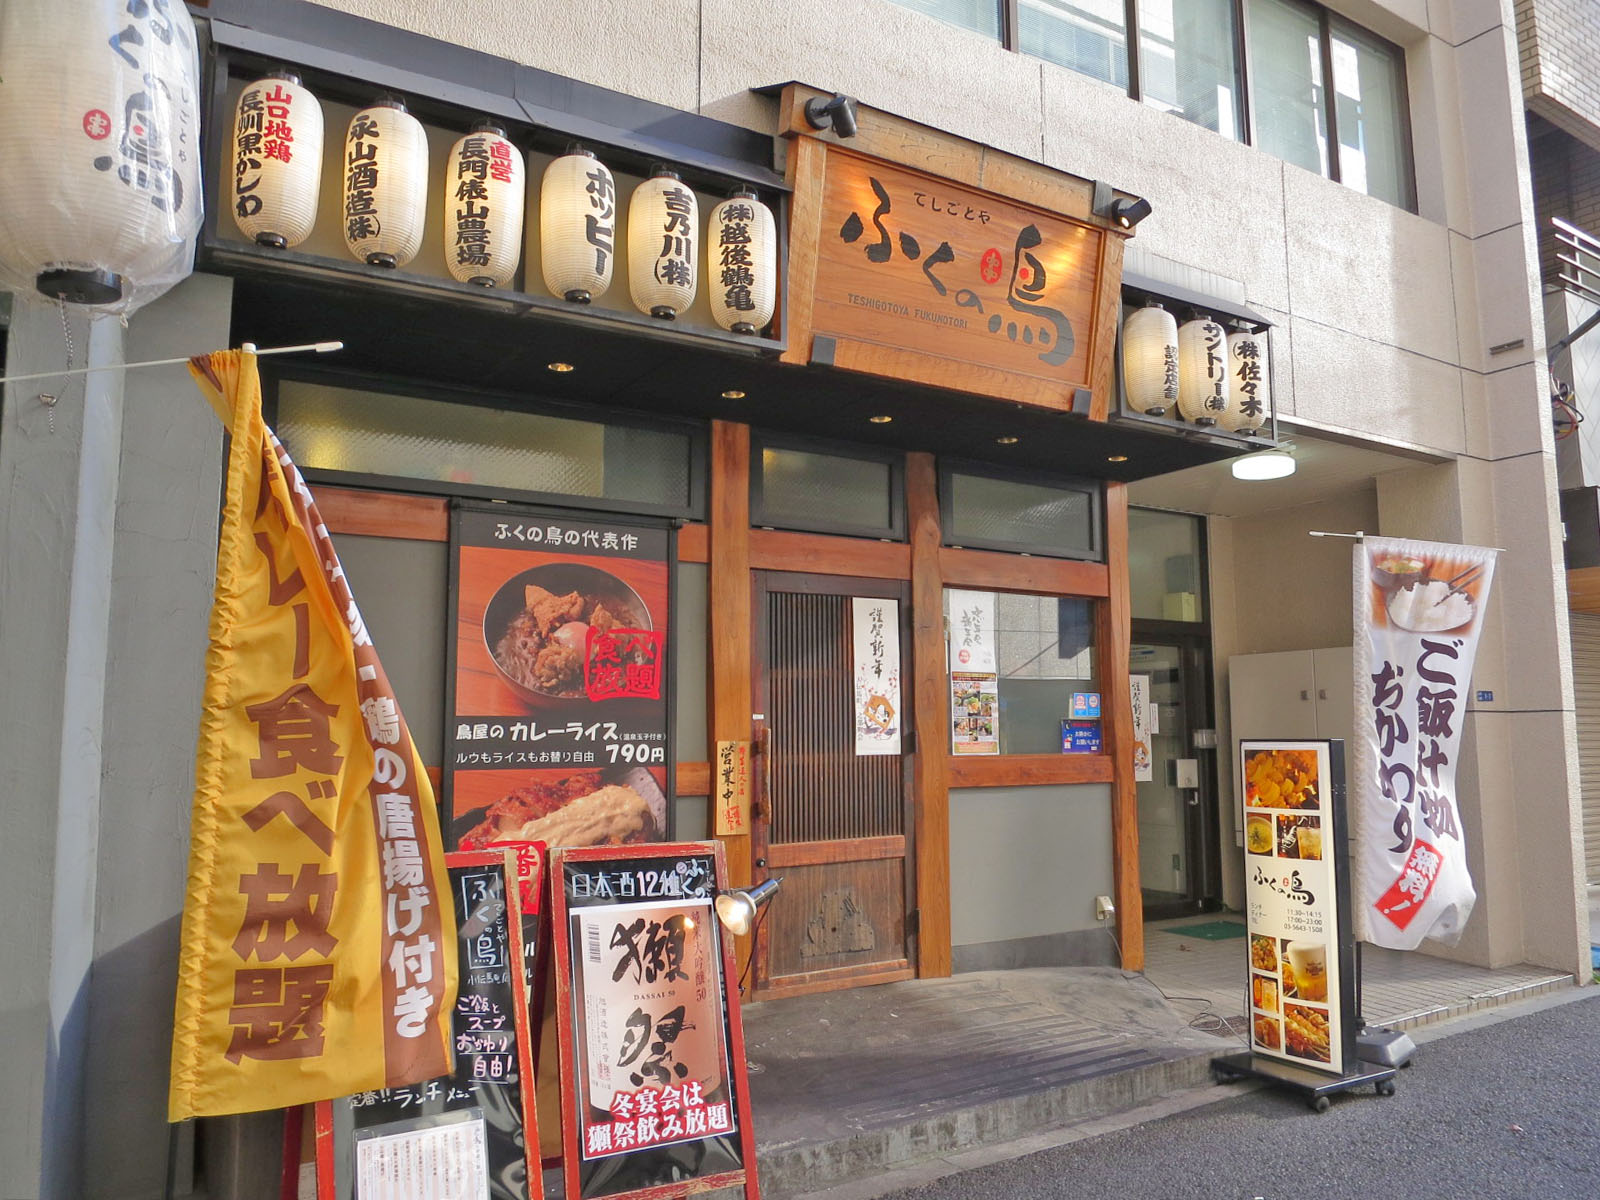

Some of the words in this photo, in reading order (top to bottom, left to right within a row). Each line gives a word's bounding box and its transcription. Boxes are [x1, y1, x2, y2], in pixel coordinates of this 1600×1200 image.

[263, 84, 295, 164] 山口地鶏
[236, 90, 264, 219] 長州黒かしわ
[489, 141, 513, 184] 直営
[455, 138, 492, 267] 長門俵山農場
[914, 192, 991, 225] てしごとや
[840, 176, 1075, 367] ふくの鳥
[848, 292, 909, 316] TESHIGOTOYA
[914, 308, 968, 329] FUKUNOTORI
[494, 523, 639, 551] ふくの鳥の代表作
[869, 607, 885, 679] 謹賀新年
[456, 721, 618, 742] 鳥屋のカレーライス
[1416, 638, 1464, 842] ご飯汁物
[455, 751, 595, 764] ルウもライスもお替り自由
[605, 743, 665, 764] 790円
[1371, 660, 1416, 853] おかわり
[720, 745, 736, 806] 営業中
[1253, 865, 1316, 906] ふくの鳥
[457, 994, 500, 1014] ご飯と
[633, 991, 665, 1001] DASSAI
[469, 1016, 506, 1030] スープ
[456, 1034, 509, 1053] おかわり
[473, 1055, 513, 1079] 自由!
[612, 1081, 704, 1119] 冬宴会は
[587, 1103, 728, 1153] 獺祭飲み放題
